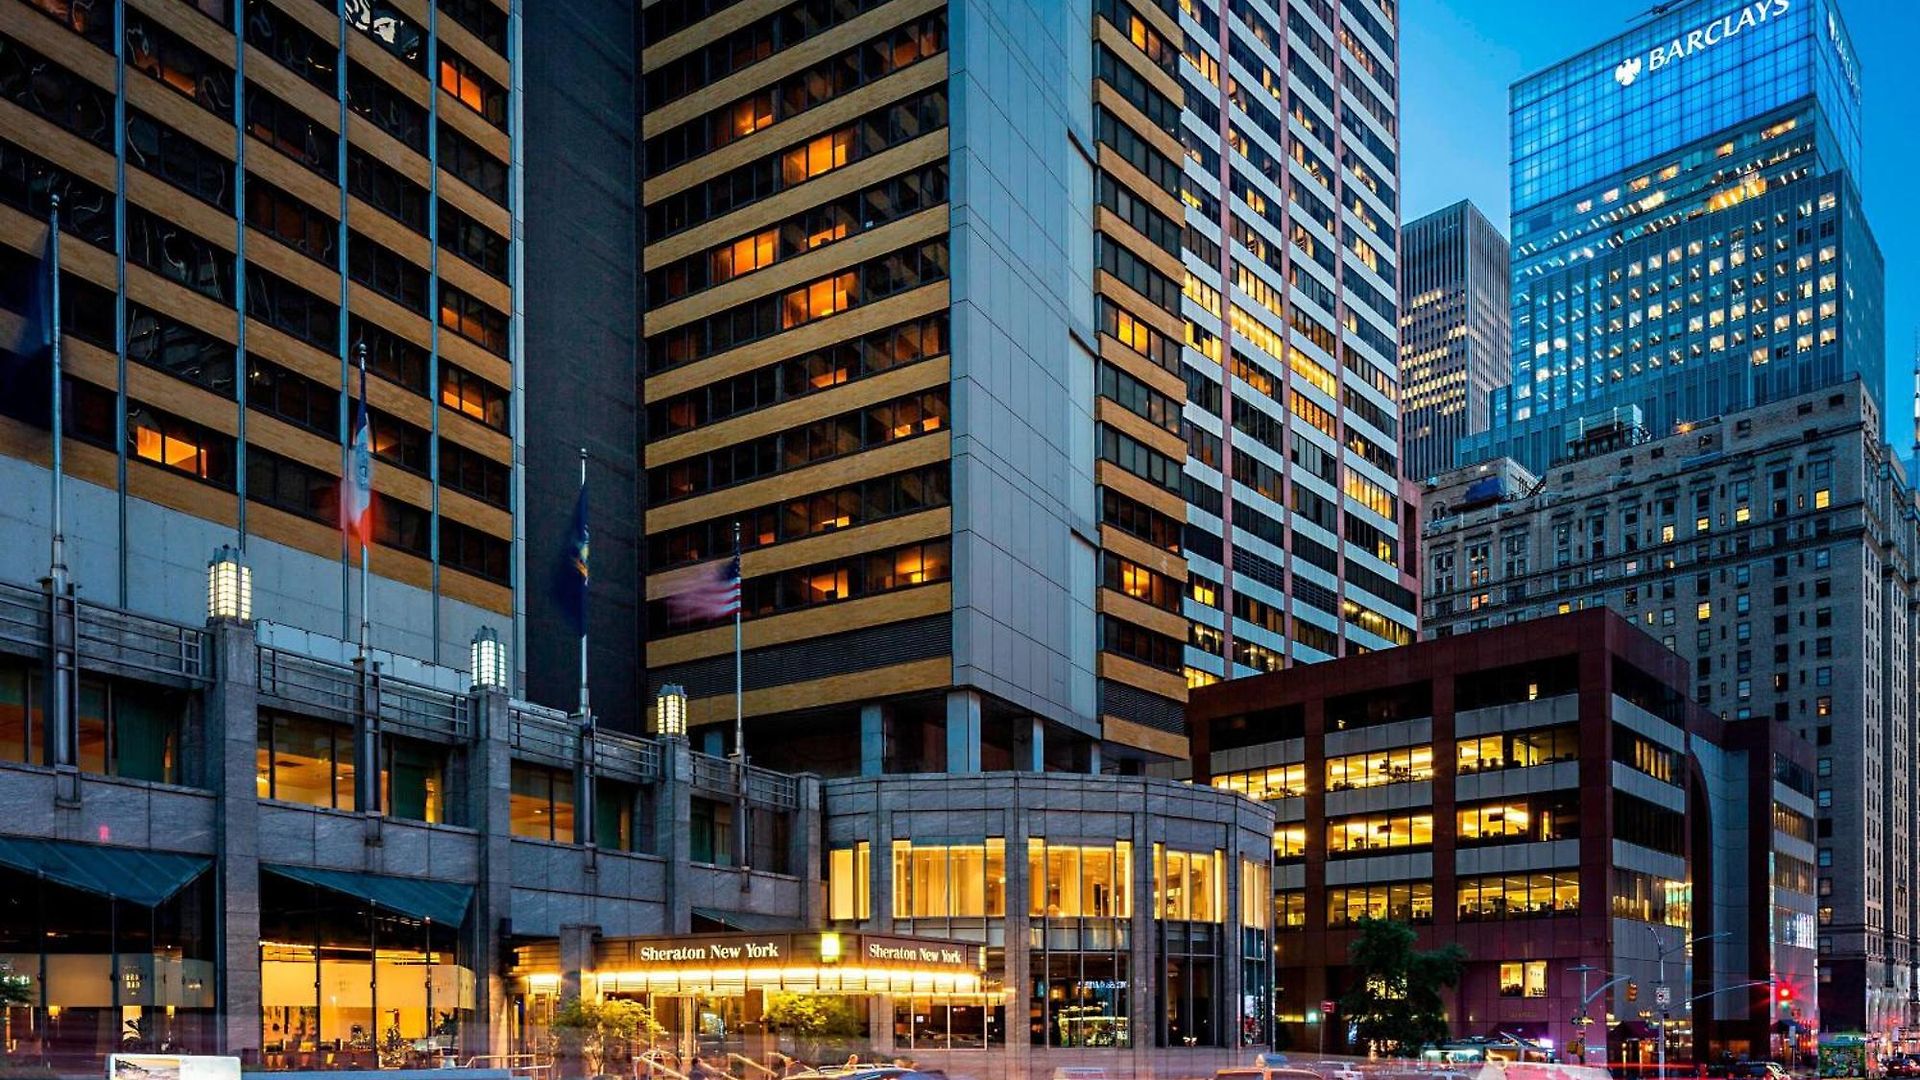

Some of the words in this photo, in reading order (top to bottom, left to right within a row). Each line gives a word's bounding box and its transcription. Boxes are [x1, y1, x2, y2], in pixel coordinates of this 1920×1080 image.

[1648, 0, 1789, 72] BARCLAYS
[640, 946, 706, 961] Sheraton
[710, 944, 741, 959] New
[745, 942, 779, 958] York
[869, 943, 916, 961] Sheraton
[919, 947, 939, 962] New
[941, 949, 962, 964] York
